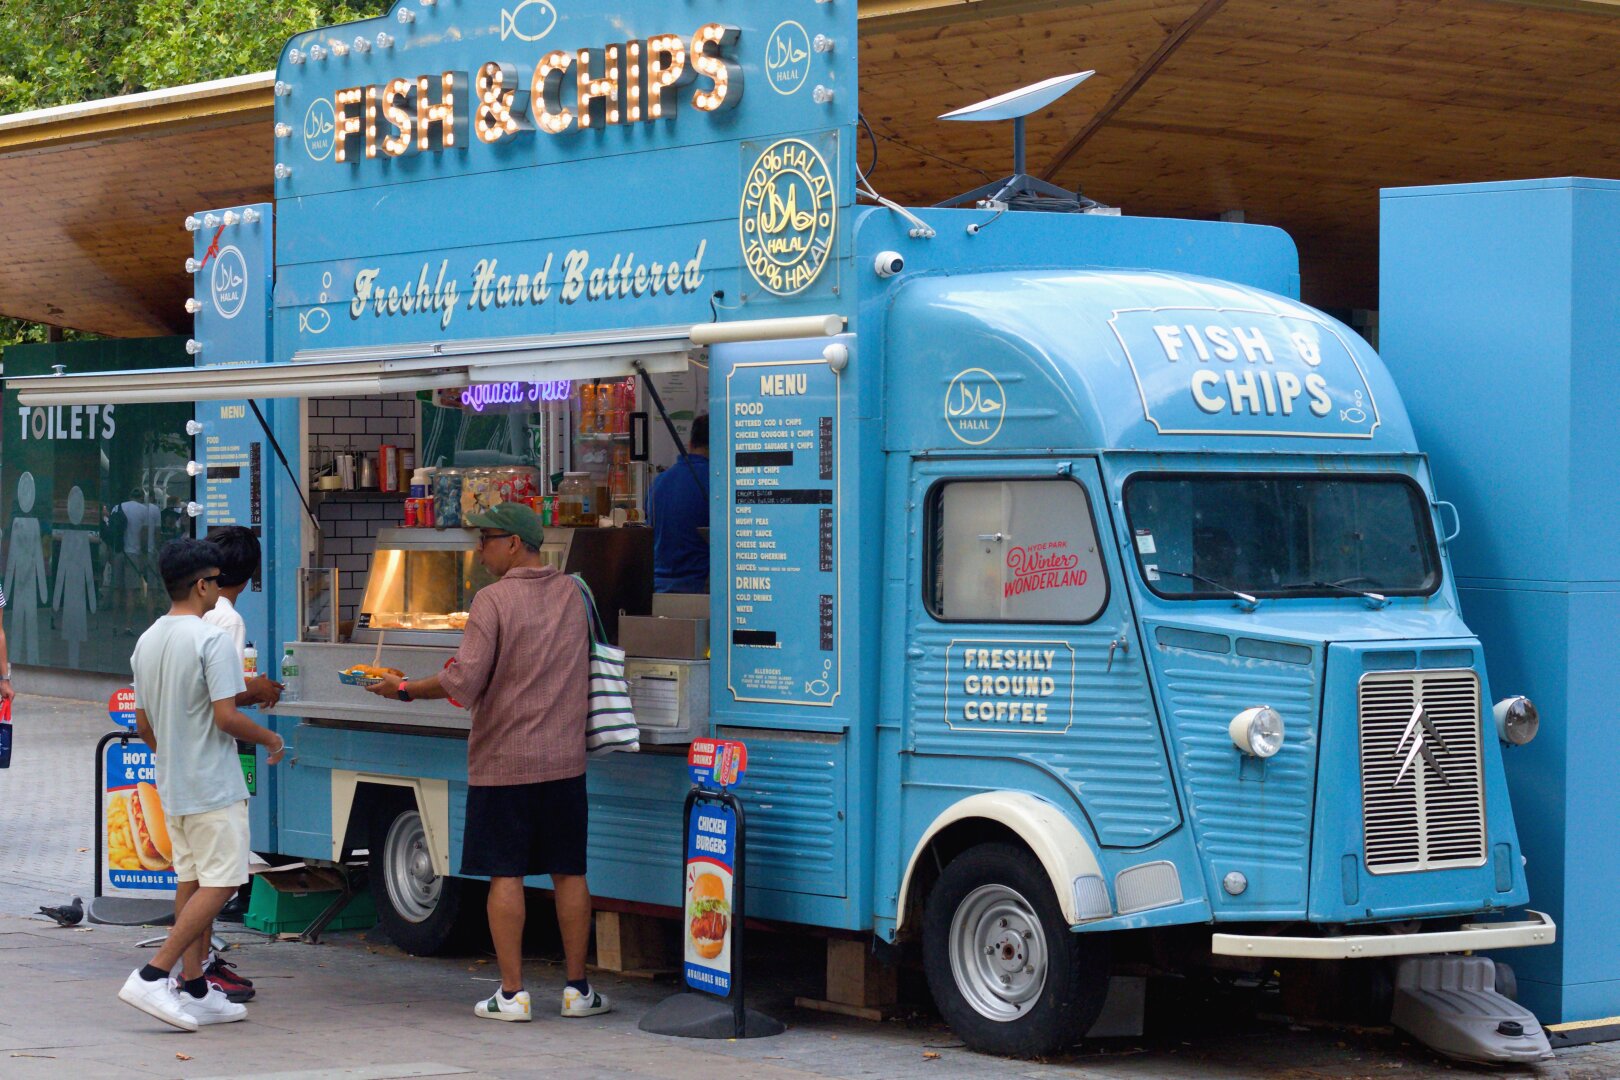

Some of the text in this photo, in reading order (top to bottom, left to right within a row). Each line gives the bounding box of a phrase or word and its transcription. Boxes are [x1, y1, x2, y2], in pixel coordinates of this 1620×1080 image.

[769, 35, 807, 69] حلال
[776, 69, 799, 81] HALAL
[335, 23, 735, 163] FISH & CHIPS
[306, 110, 334, 139] حلال
[784, 145, 832, 209] HALAL
[761, 182, 816, 233] حلال
[767, 237, 805, 253] HALAL
[785, 235, 831, 290] HALAL
[216, 263, 243, 292] حلال
[350, 239, 707, 330] Freshly Hand Battered
[220, 291, 239, 302] HALAL
[1153, 324, 1274, 363] FISH
[760, 374, 807, 396] MENU
[949, 381, 1002, 416] حلال
[1190, 369, 1333, 417] CHIPS
[220, 405, 245, 419] MENU
[735, 402, 764, 416] FOOD
[18, 404, 116, 440] TOILETS
[785, 418, 802, 426] CHIPS
[959, 419, 990, 430] HALAL
[206, 437, 220, 445] FOOD
[735, 431, 759, 439] CHICKEN
[797, 429, 814, 437] CHIPS
[797, 441, 814, 449] CHIPS
[763, 466, 780, 474] CHIPS
[735, 478, 780, 486] WEEKLY SPECIAL
[735, 506, 752, 514] CHIPS
[735, 518, 769, 526] MUSHY PEAS
[755, 530, 773, 538] SAUCE
[735, 541, 776, 549] CHEESE SAUCE
[1027, 541, 1068, 553] HYDE PARK
[735, 552, 758, 560] PICKLED
[1006, 546, 1079, 577] Winter
[735, 576, 771, 590] DRINKS
[1004, 569, 1088, 598] WONDERLAND
[735, 594, 773, 602] COLD DRINKS
[735, 605, 753, 613] WATER
[735, 616, 747, 624] TEA
[963, 648, 1056, 671] FRESHLY
[964, 674, 1056, 697] GROUND
[117, 692, 136, 701] CAN
[963, 700, 1049, 724] COFFEE
[693, 742, 715, 754] CANNED
[122, 752, 147, 765] HOT
[693, 754, 713, 766] DRINKS
[125, 767, 135, 780] &
[697, 815, 728, 835] CHICKEN
[695, 834, 727, 855] BURGERS
[114, 874, 178, 884] AVAILABLE HE
[687, 968, 729, 988] AVAILABLE HERE
